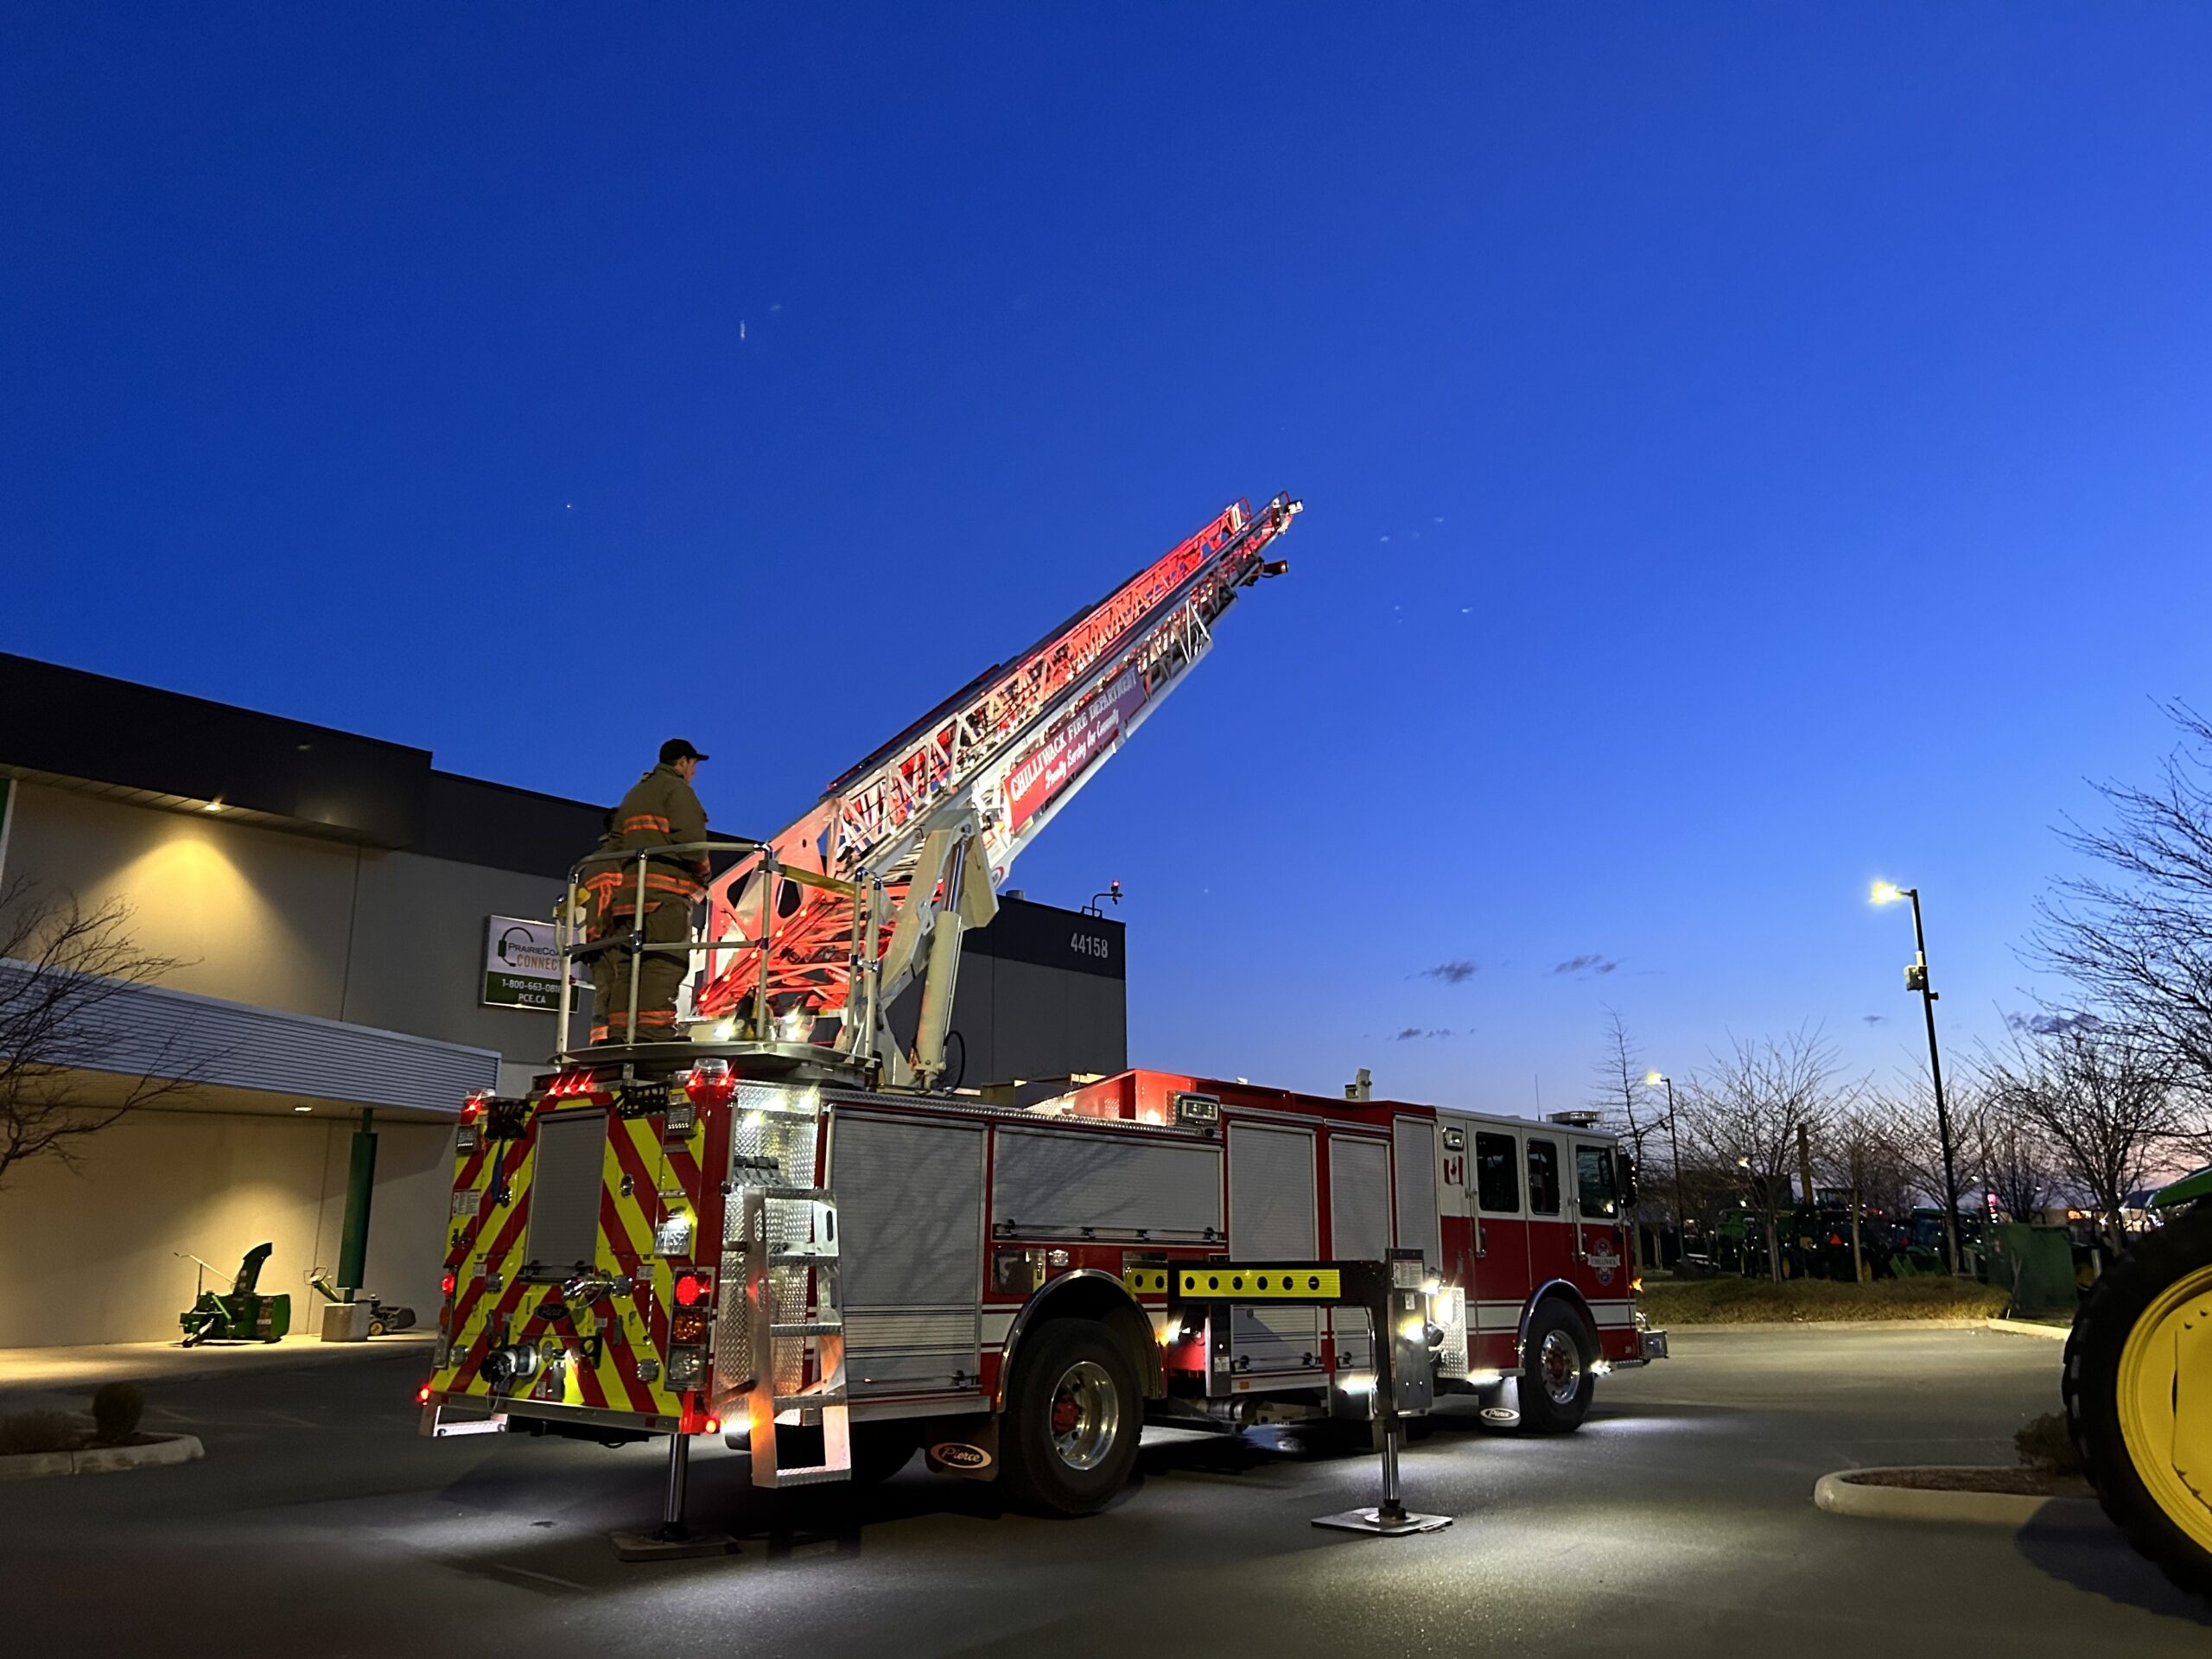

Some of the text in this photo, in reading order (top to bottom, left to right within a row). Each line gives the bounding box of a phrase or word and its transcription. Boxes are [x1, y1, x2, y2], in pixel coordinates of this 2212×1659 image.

[1010, 667, 1137, 802] CHILLIWACK FIRE DEPARTMENT
[1071, 932, 1109, 958] 44158
[518, 993, 546, 1004] PCE.CA
[941, 1446, 982, 1463] Pierce
